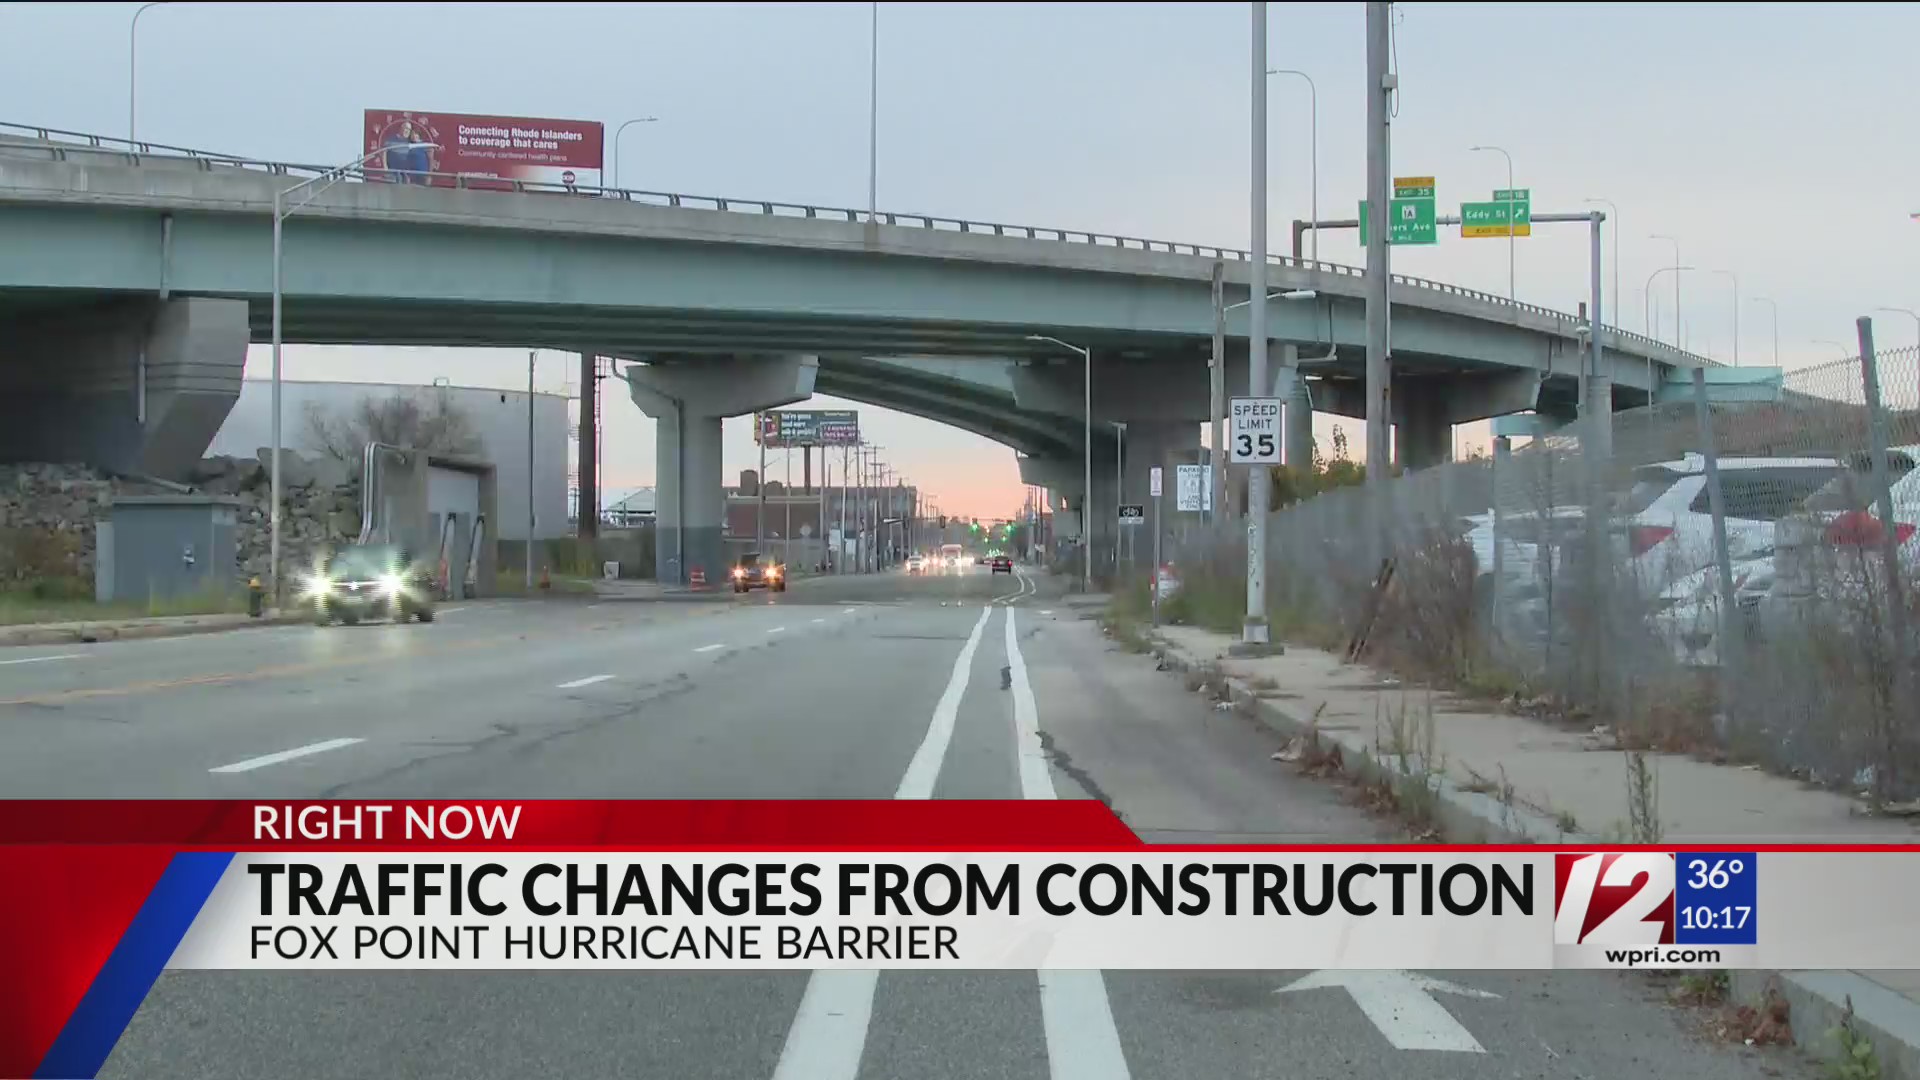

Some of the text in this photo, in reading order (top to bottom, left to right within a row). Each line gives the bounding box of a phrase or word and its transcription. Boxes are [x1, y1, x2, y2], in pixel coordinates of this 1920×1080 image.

[458, 125, 583, 141] Connecting Rhode Islanders
[458, 135, 558, 149] to coverage that cares
[458, 149, 497, 159] Community
[528, 153, 549, 161] health
[1417, 188, 1430, 196] 35
[1465, 210, 1506, 220] Eddy St
[1412, 223, 1431, 231] Ave
[1234, 404, 1278, 416] SPEED
[1238, 418, 1273, 430] LIMIT
[1236, 434, 1275, 457] 35
